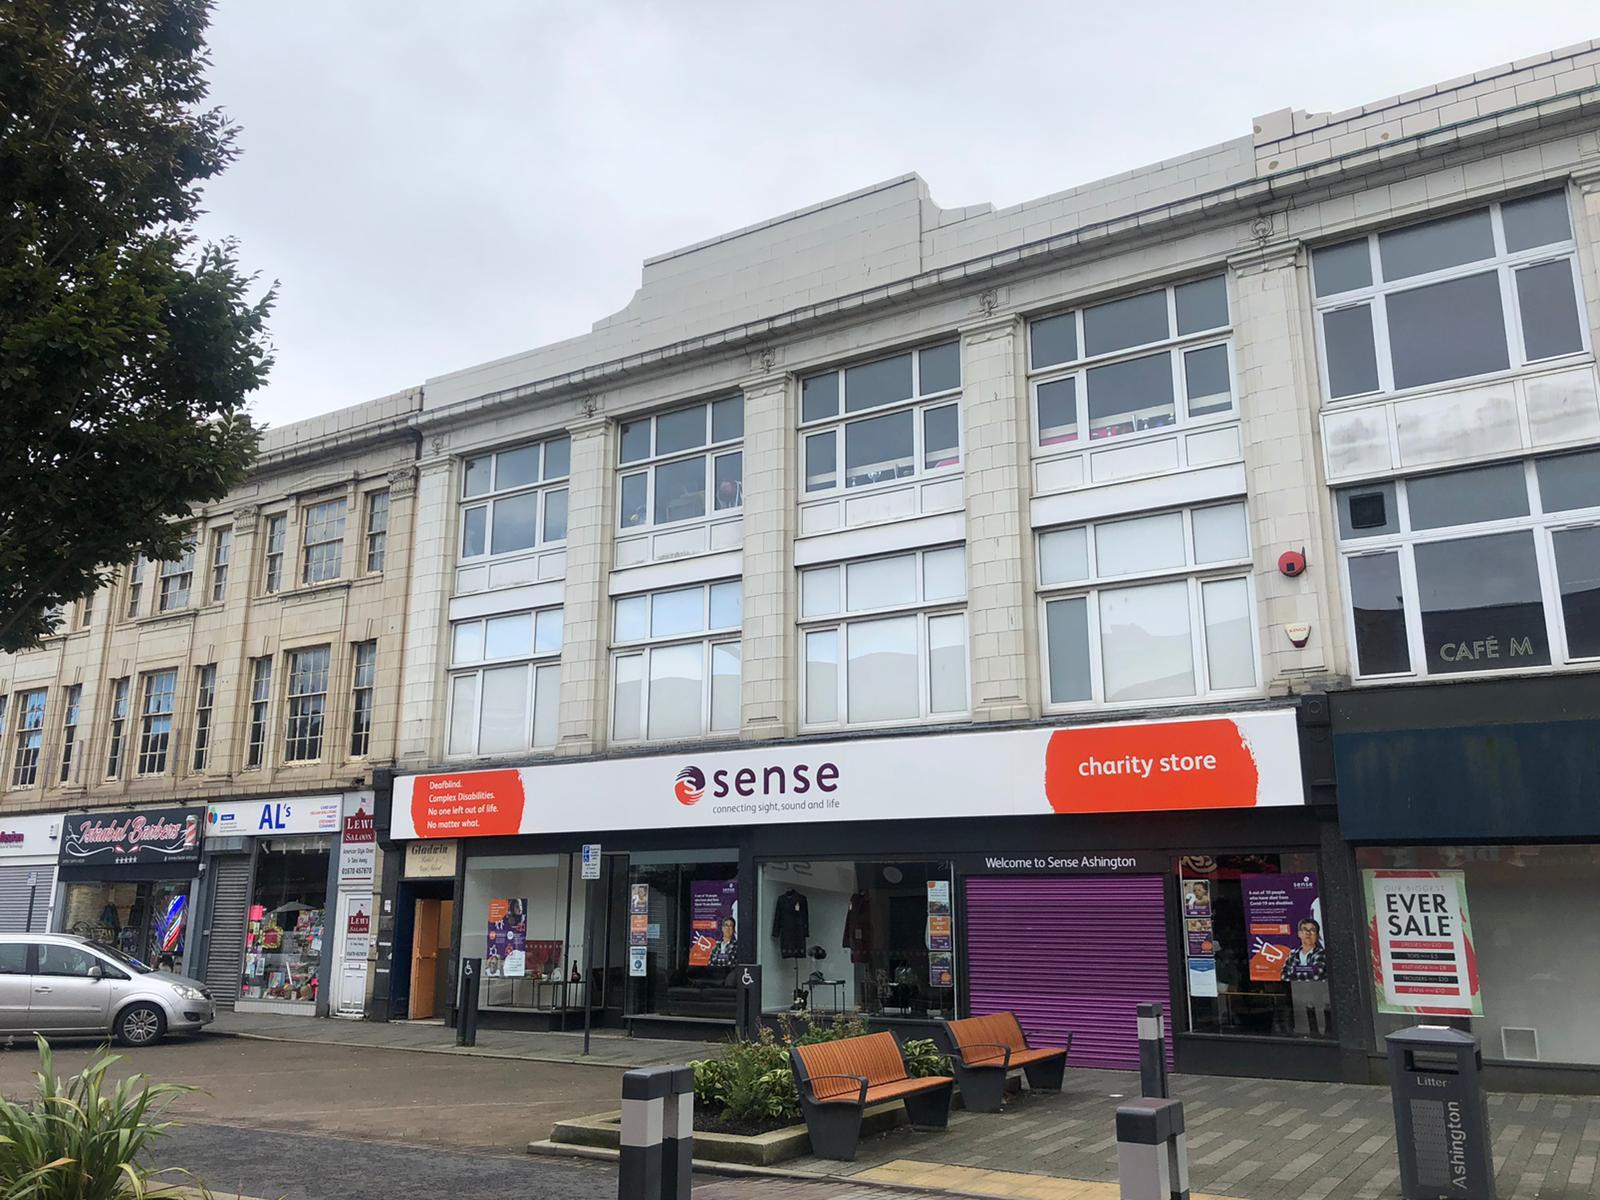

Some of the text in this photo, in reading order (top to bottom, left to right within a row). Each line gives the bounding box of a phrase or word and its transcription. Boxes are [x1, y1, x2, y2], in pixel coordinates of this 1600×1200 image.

[1440, 635, 1533, 662] CAFÉ M
[1078, 752, 1217, 778] charity store
[429, 780, 462, 790] Deafblind.
[713, 763, 840, 798] sense
[428, 792, 495, 804] Complex Disabilities.
[712, 798, 840, 814] connecting sight, sound and life
[428, 807, 437, 816] No
[452, 806, 464, 815] left
[465, 806, 476, 814] out
[477, 805, 485, 813] of
[486, 804, 499, 813] life.
[347, 818, 373, 830] LEWI
[427, 819, 480, 829] No matter what.
[985, 855, 1136, 871] Welcome to Sense Ashington
[1386, 893, 1448, 913] EVER
[1416, 1076, 1447, 1087] Litter
[1447, 1101, 1468, 1190] Ashington
